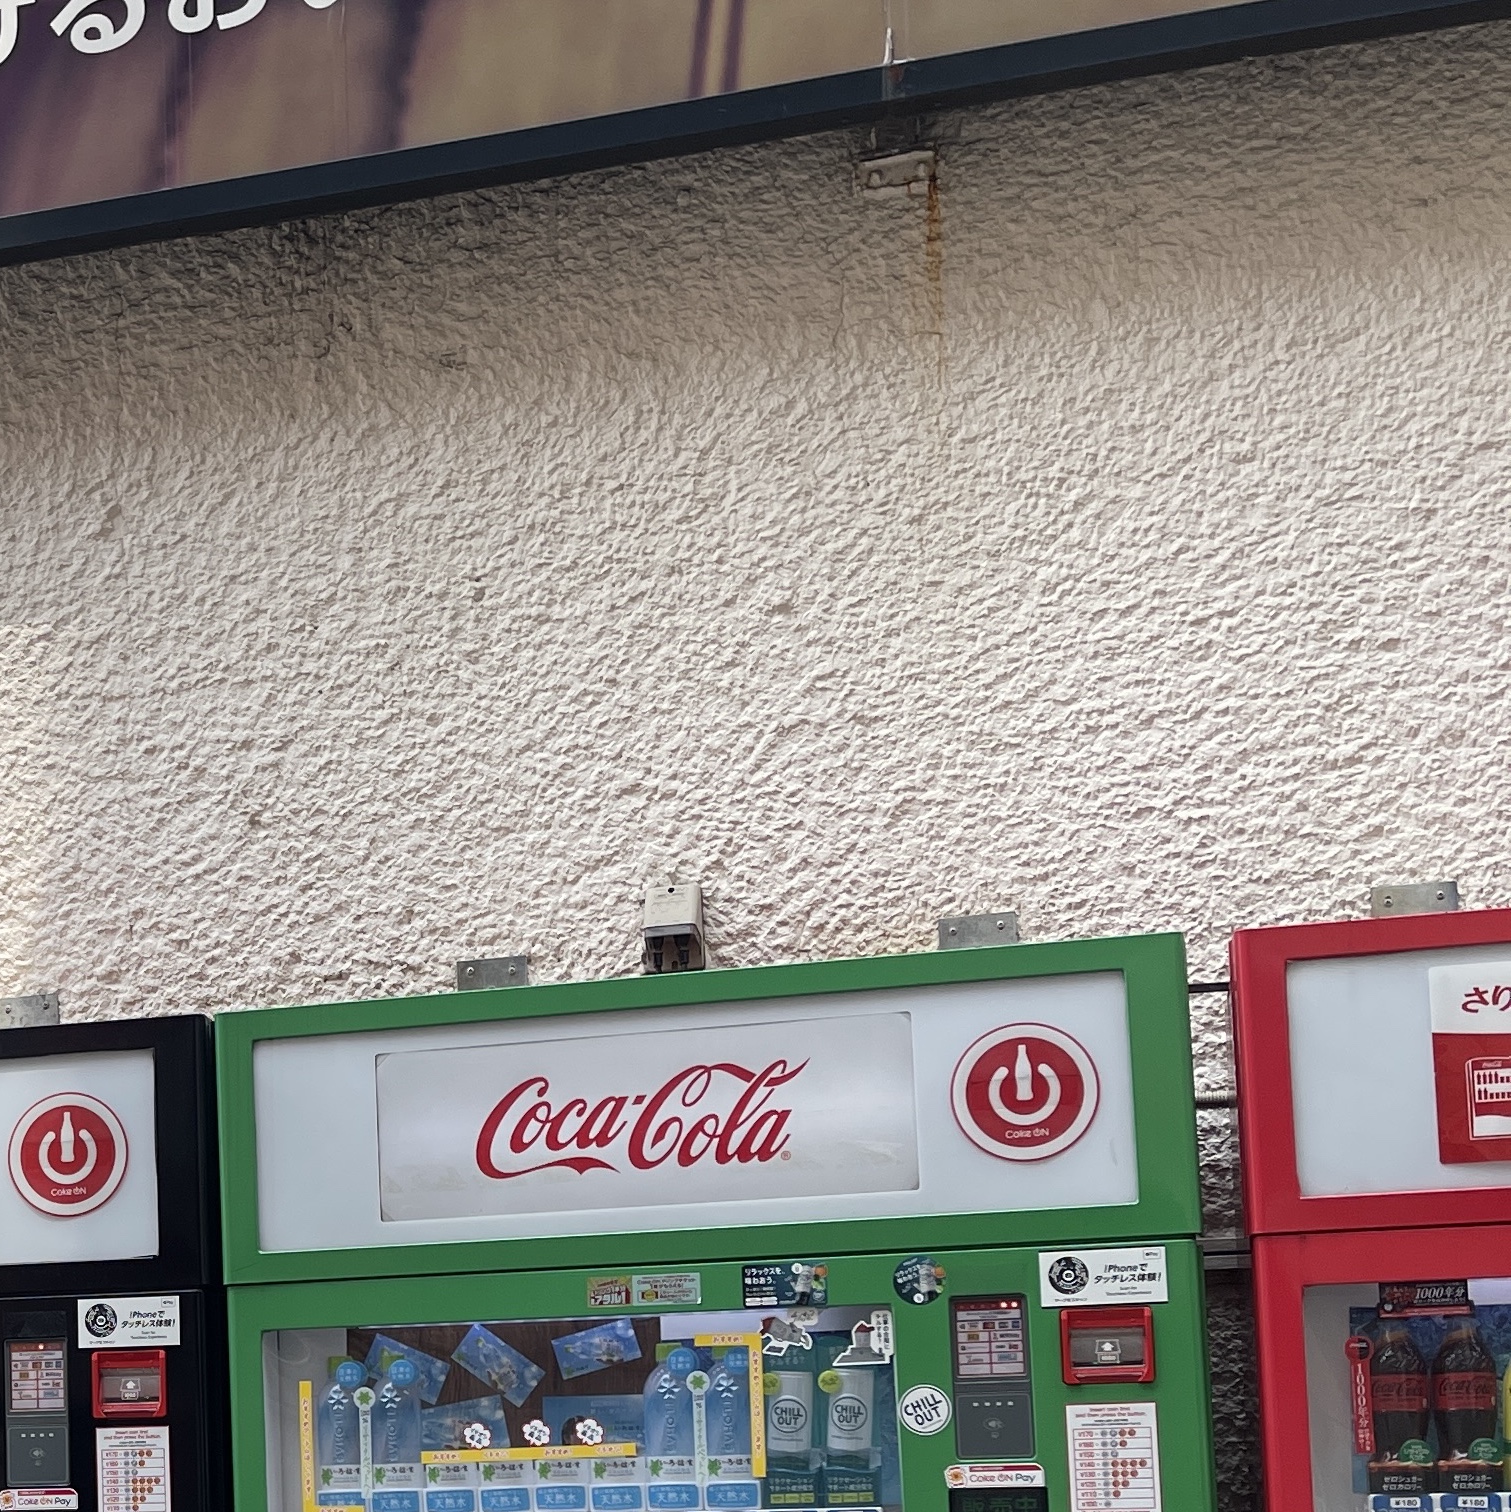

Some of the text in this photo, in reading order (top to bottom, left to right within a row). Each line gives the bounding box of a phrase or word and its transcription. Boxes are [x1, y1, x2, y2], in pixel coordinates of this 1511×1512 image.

[476, 1057, 809, 1179] Coca-Cola
[1104, 1263, 1148, 1273] iPhoneで
[1093, 1272, 1162, 1284] タッチレス体験!
[1415, 1287, 1465, 1298] 1000年分
[129, 1310, 165, 1319] iPhoneで
[121, 1319, 176, 1330] タッチレス体験!
[833, 1404, 864, 1416] CHILL
[904, 1393, 942, 1416] CHILL
[774, 1407, 803, 1418] CHILL
[914, 1407, 941, 1426] OUT
[777, 1415, 799, 1426] OUT
[837, 1413, 860, 1424] OUT
[969, 1475, 995, 1483] Coke
[1015, 1473, 1036, 1485] Pay
[54, 1497, 72, 1508] Pay
